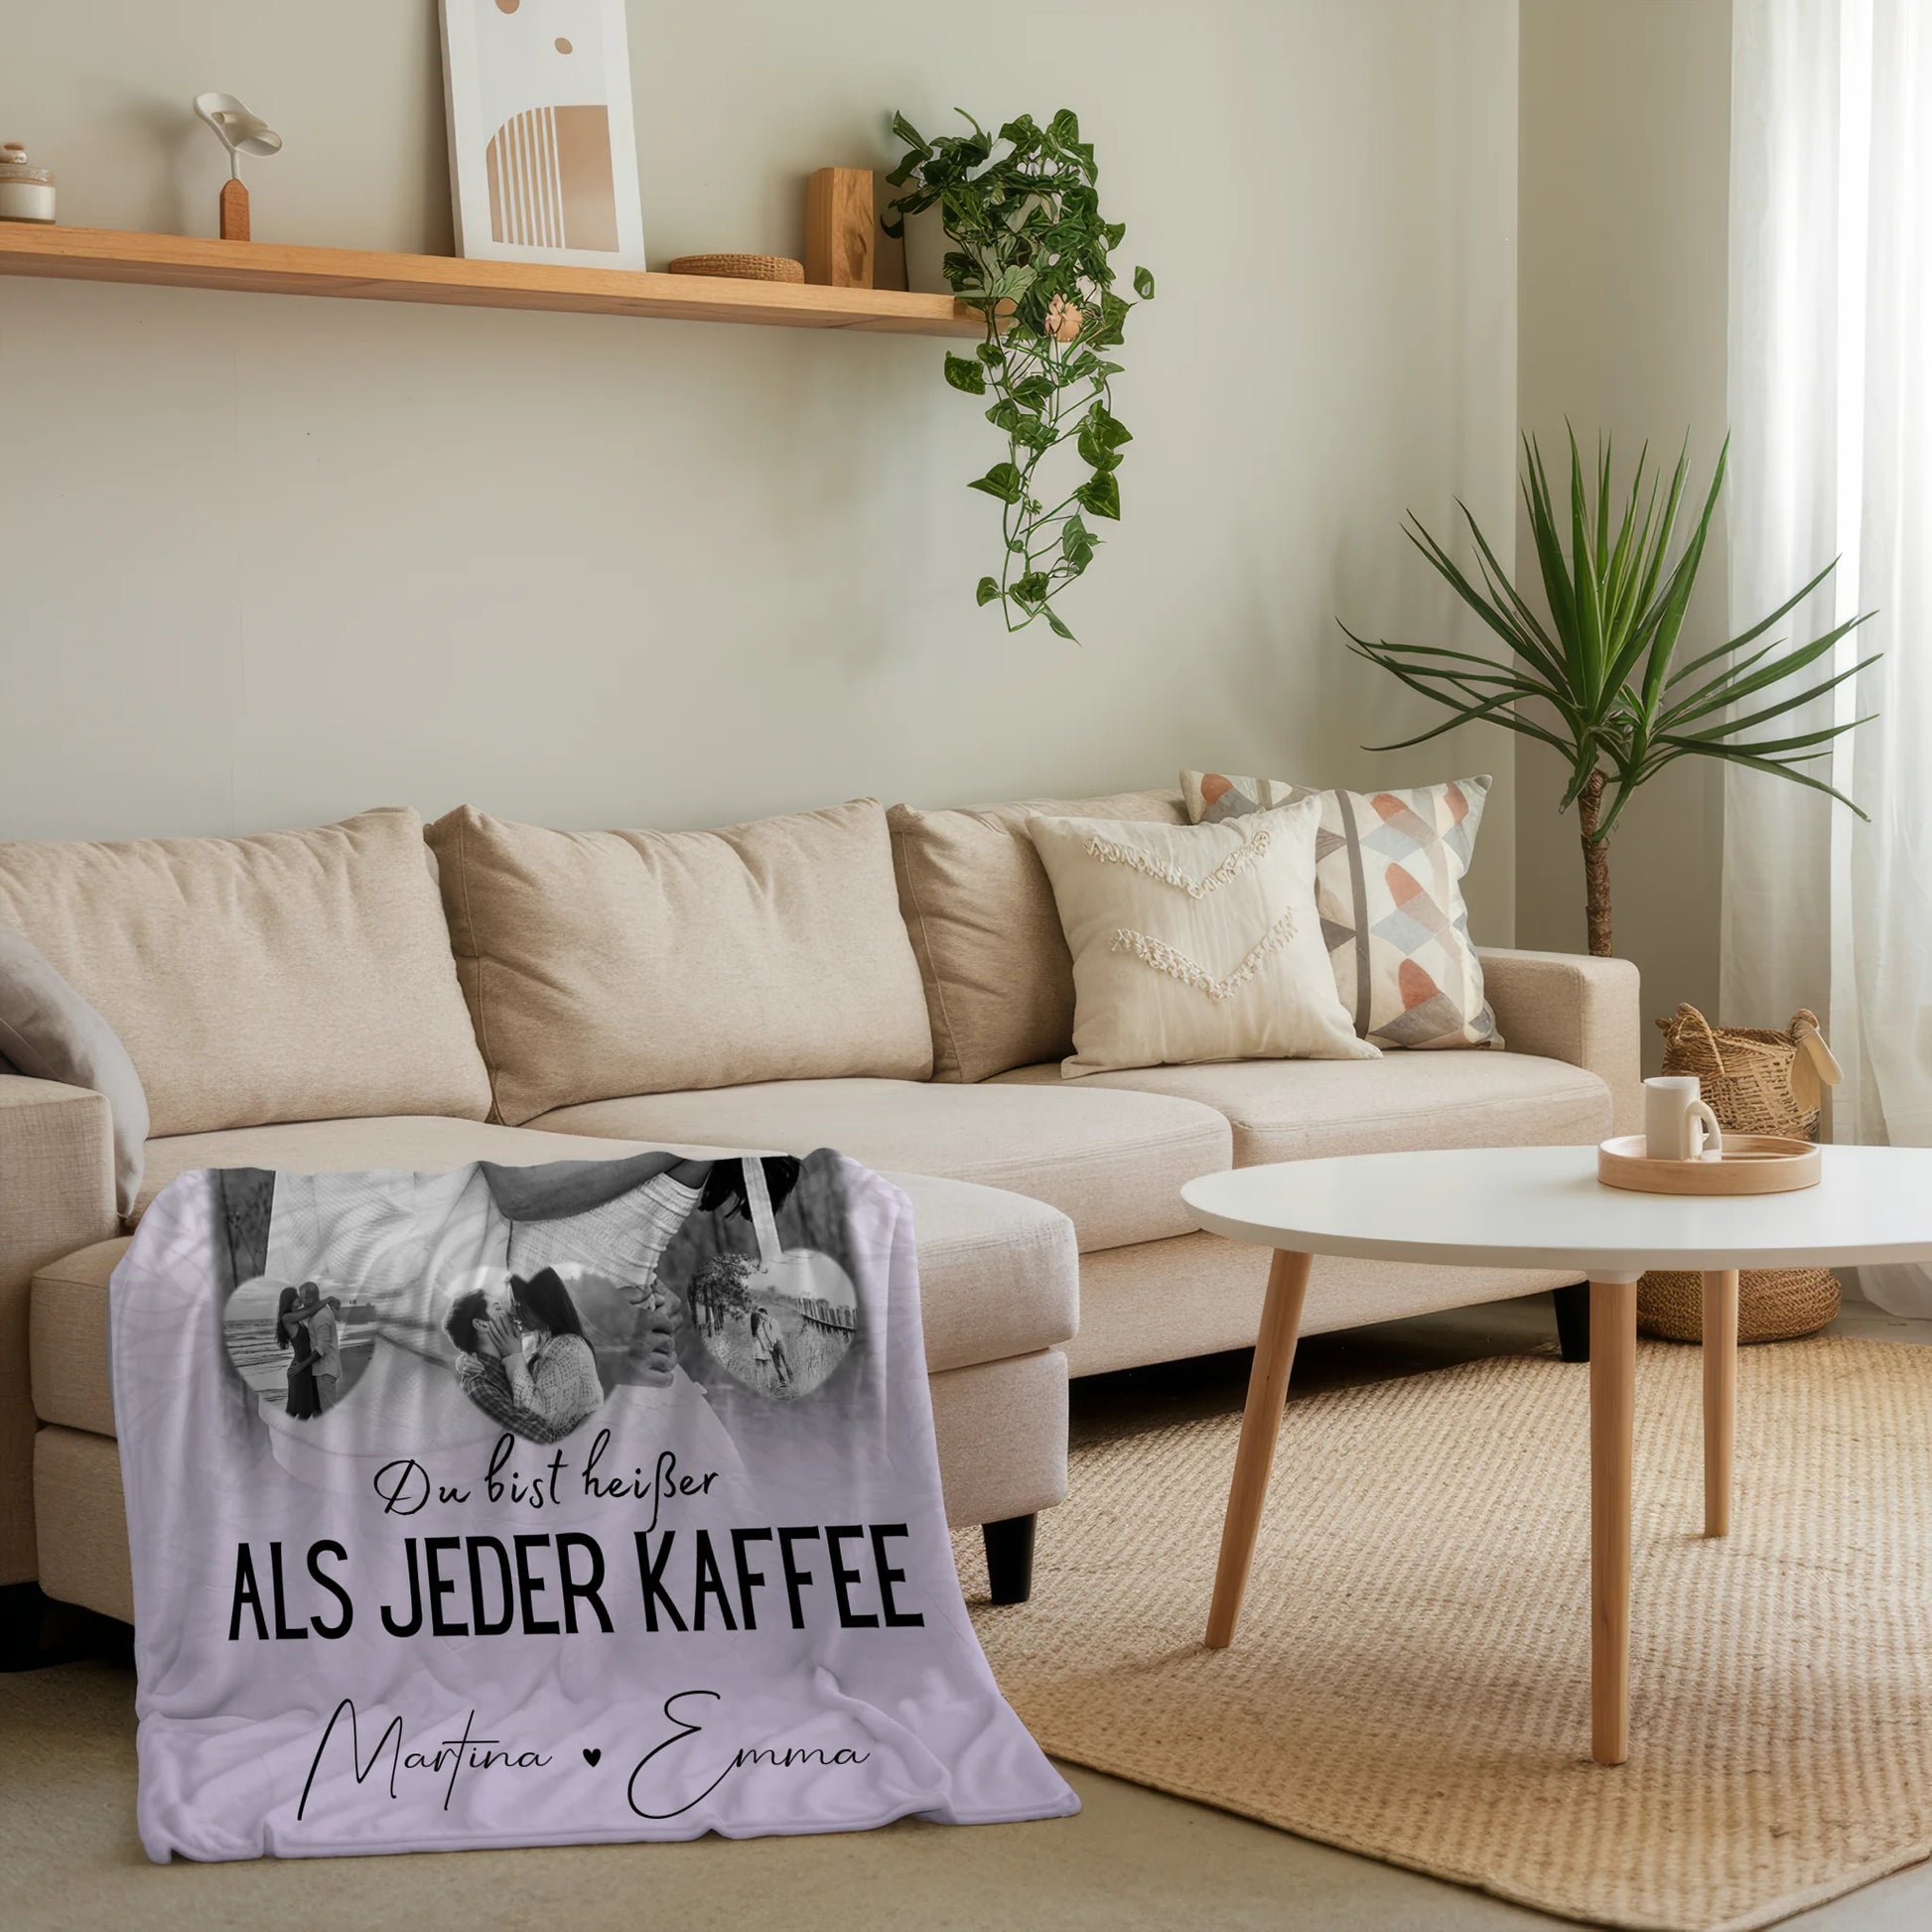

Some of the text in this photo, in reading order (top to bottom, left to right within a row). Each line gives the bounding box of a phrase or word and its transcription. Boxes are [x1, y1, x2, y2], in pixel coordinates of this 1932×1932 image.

[373, 1429, 720, 1533] Du bist heißer
[228, 1523, 924, 1640] ALS JEDER KAFFEE
[297, 1691, 871, 1821] Martina Emma
